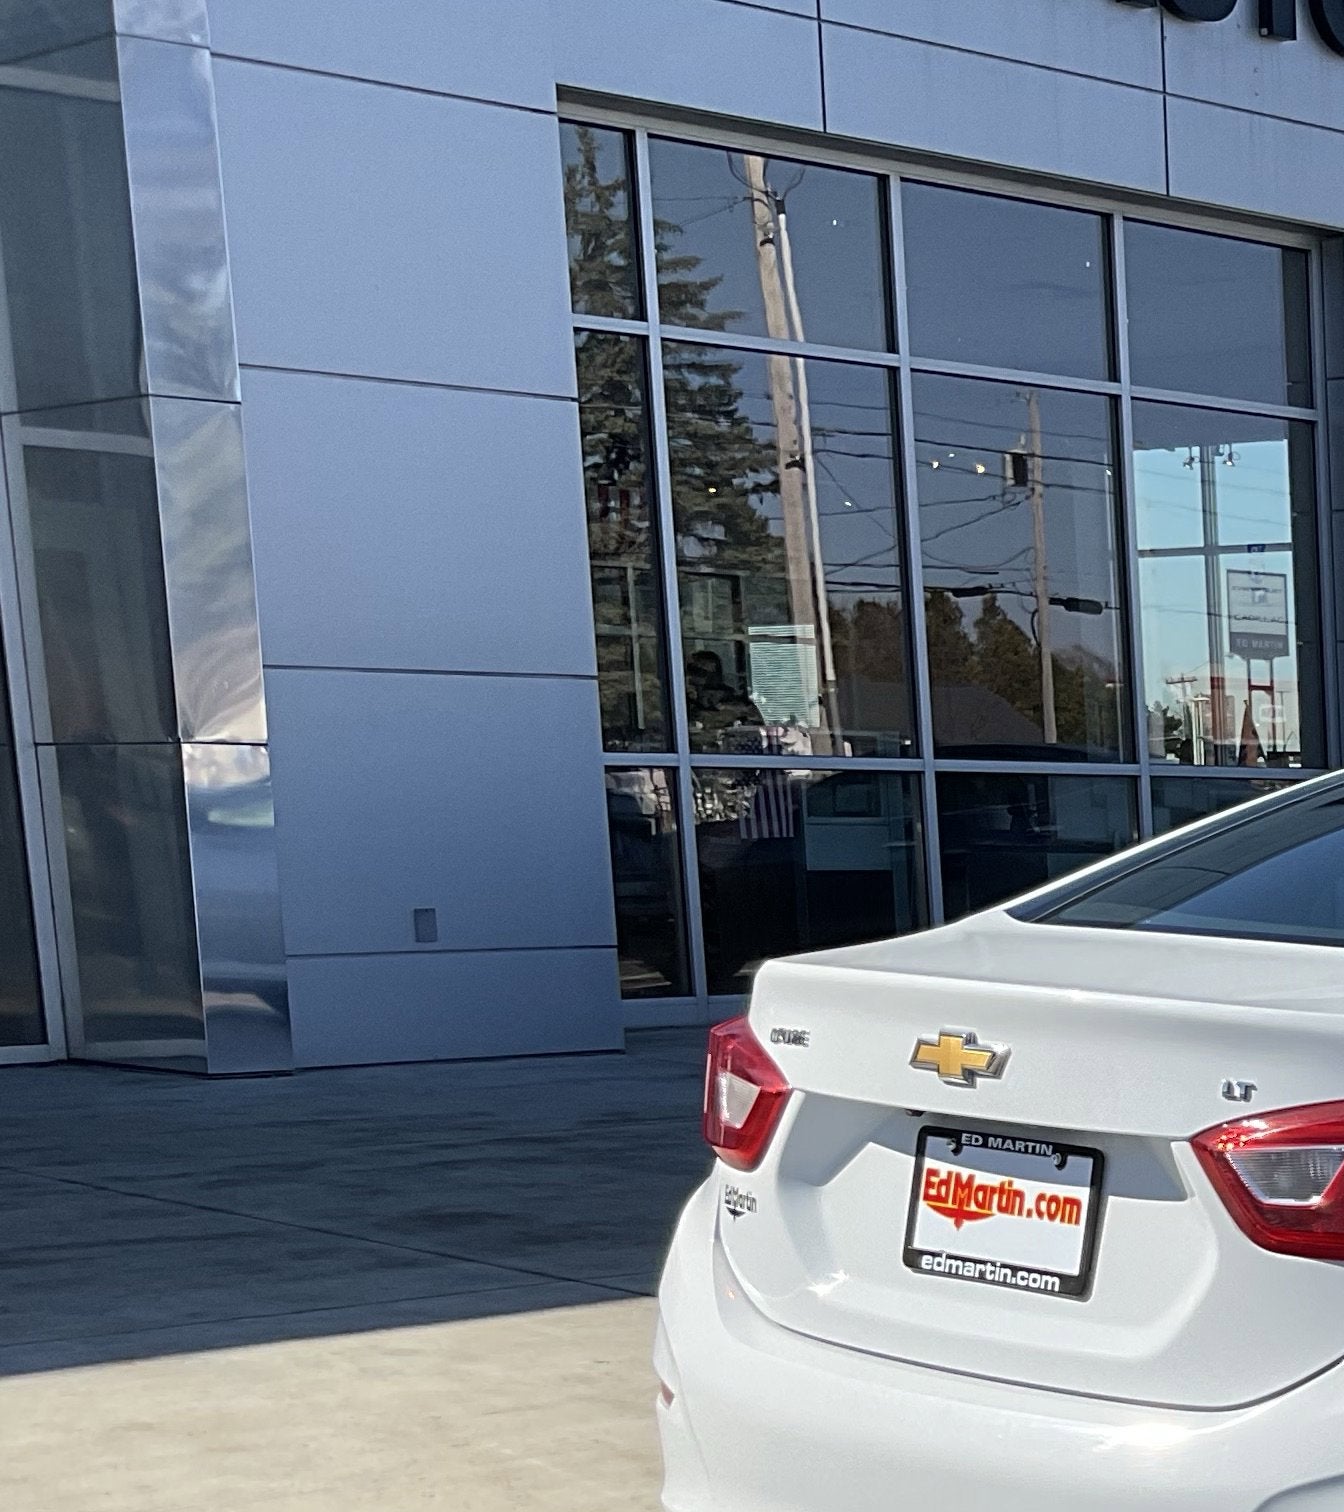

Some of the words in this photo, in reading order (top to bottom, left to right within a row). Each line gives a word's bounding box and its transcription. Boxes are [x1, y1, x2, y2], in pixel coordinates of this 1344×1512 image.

[1221, 1079, 1258, 1102] LT
[961, 1133, 983, 1146] ED
[987, 1136, 1054, 1156] MARTIN
[922, 1167, 1083, 1226] EdMartin.com
[921, 1252, 1061, 1292] edmartin.com
